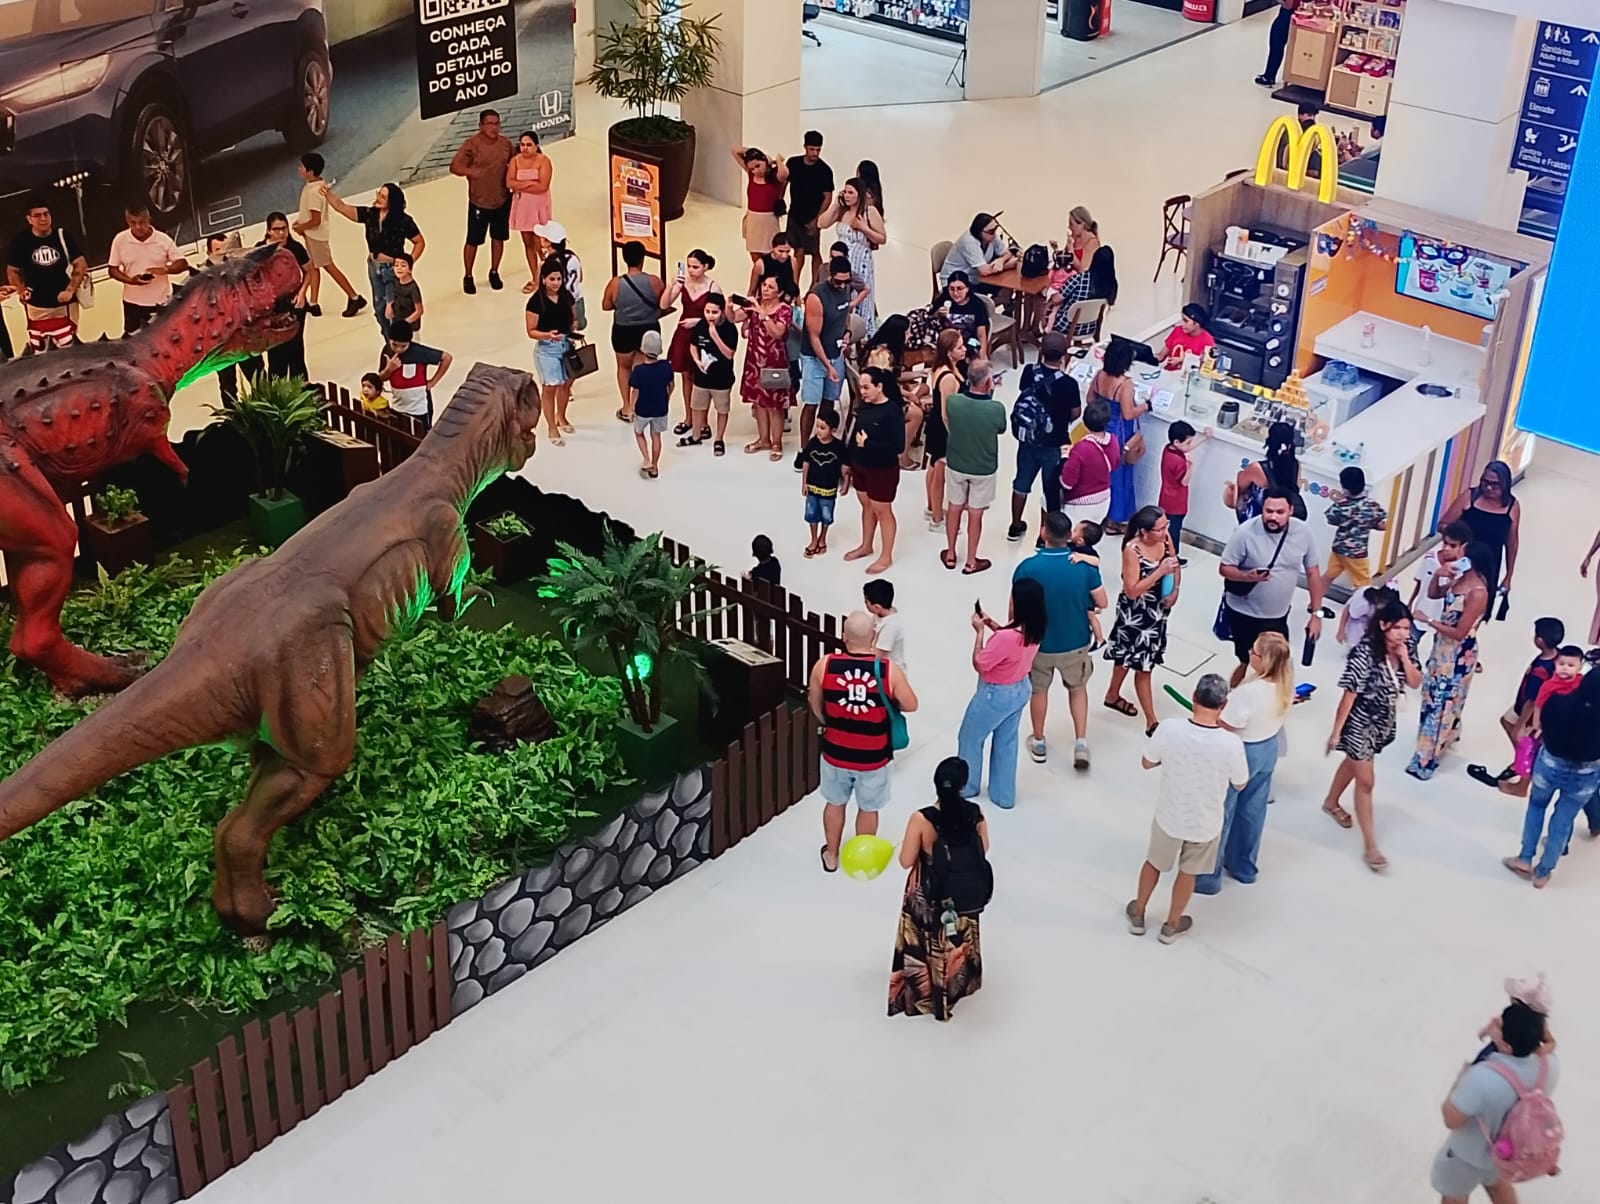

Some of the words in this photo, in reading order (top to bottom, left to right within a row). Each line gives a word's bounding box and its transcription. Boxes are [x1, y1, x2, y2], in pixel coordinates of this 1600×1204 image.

[430, 15, 506, 43] CONHEÇA
[448, 35, 491, 55] CADA
[436, 47, 504, 75] DETALHE
[429, 77, 451, 93] DO
[455, 67, 487, 86] SUV
[491, 61, 512, 77] DO
[455, 84, 488, 102] ANO
[532, 114, 571, 131] HONDA
[847, 683, 867, 702] 19
